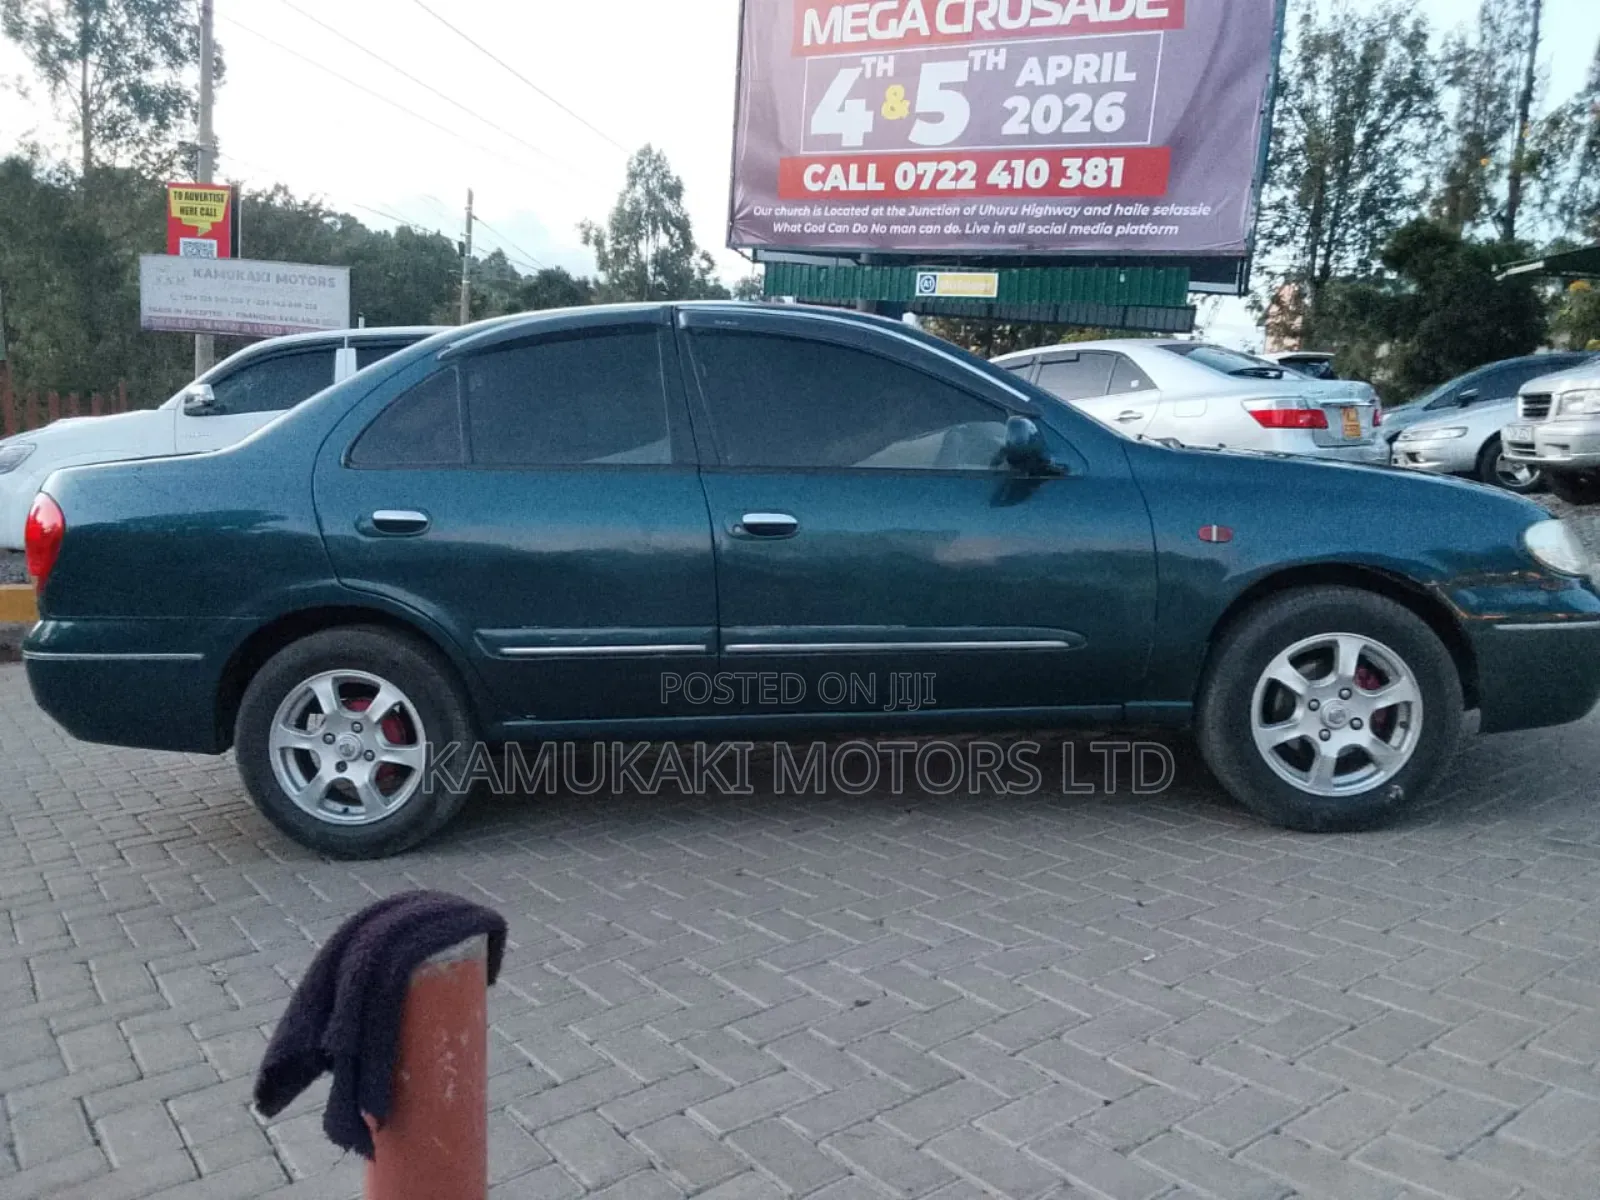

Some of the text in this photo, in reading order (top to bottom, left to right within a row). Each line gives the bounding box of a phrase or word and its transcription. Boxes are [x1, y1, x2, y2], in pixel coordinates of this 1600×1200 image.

[803, 0, 1169, 46] MEGA CRUSADE
[1015, 51, 1137, 87] APRIL
[881, 84, 910, 120] &
[1001, 91, 1127, 135] 2026
[803, 157, 1125, 191] CALL 0722 410 381
[753, 203, 1211, 219] Our church is Located at the Junction of Uhuru Highway and haile selassie
[772, 222, 802, 233] What
[804, 222, 826, 233] God
[828, 222, 850, 233] Can
[852, 222, 868, 233] Do
[870, 222, 887, 234] No
[889, 224, 917, 234] man
[919, 224, 941, 234] can
[964, 222, 990, 234] Live
[993, 222, 1006, 234] in
[1008, 222, 1026, 234] all
[1028, 222, 1066, 235] social
[1069, 222, 1113, 235] media
[1114, 222, 1179, 237] platform
[275, 272, 337, 288] MOTORS
